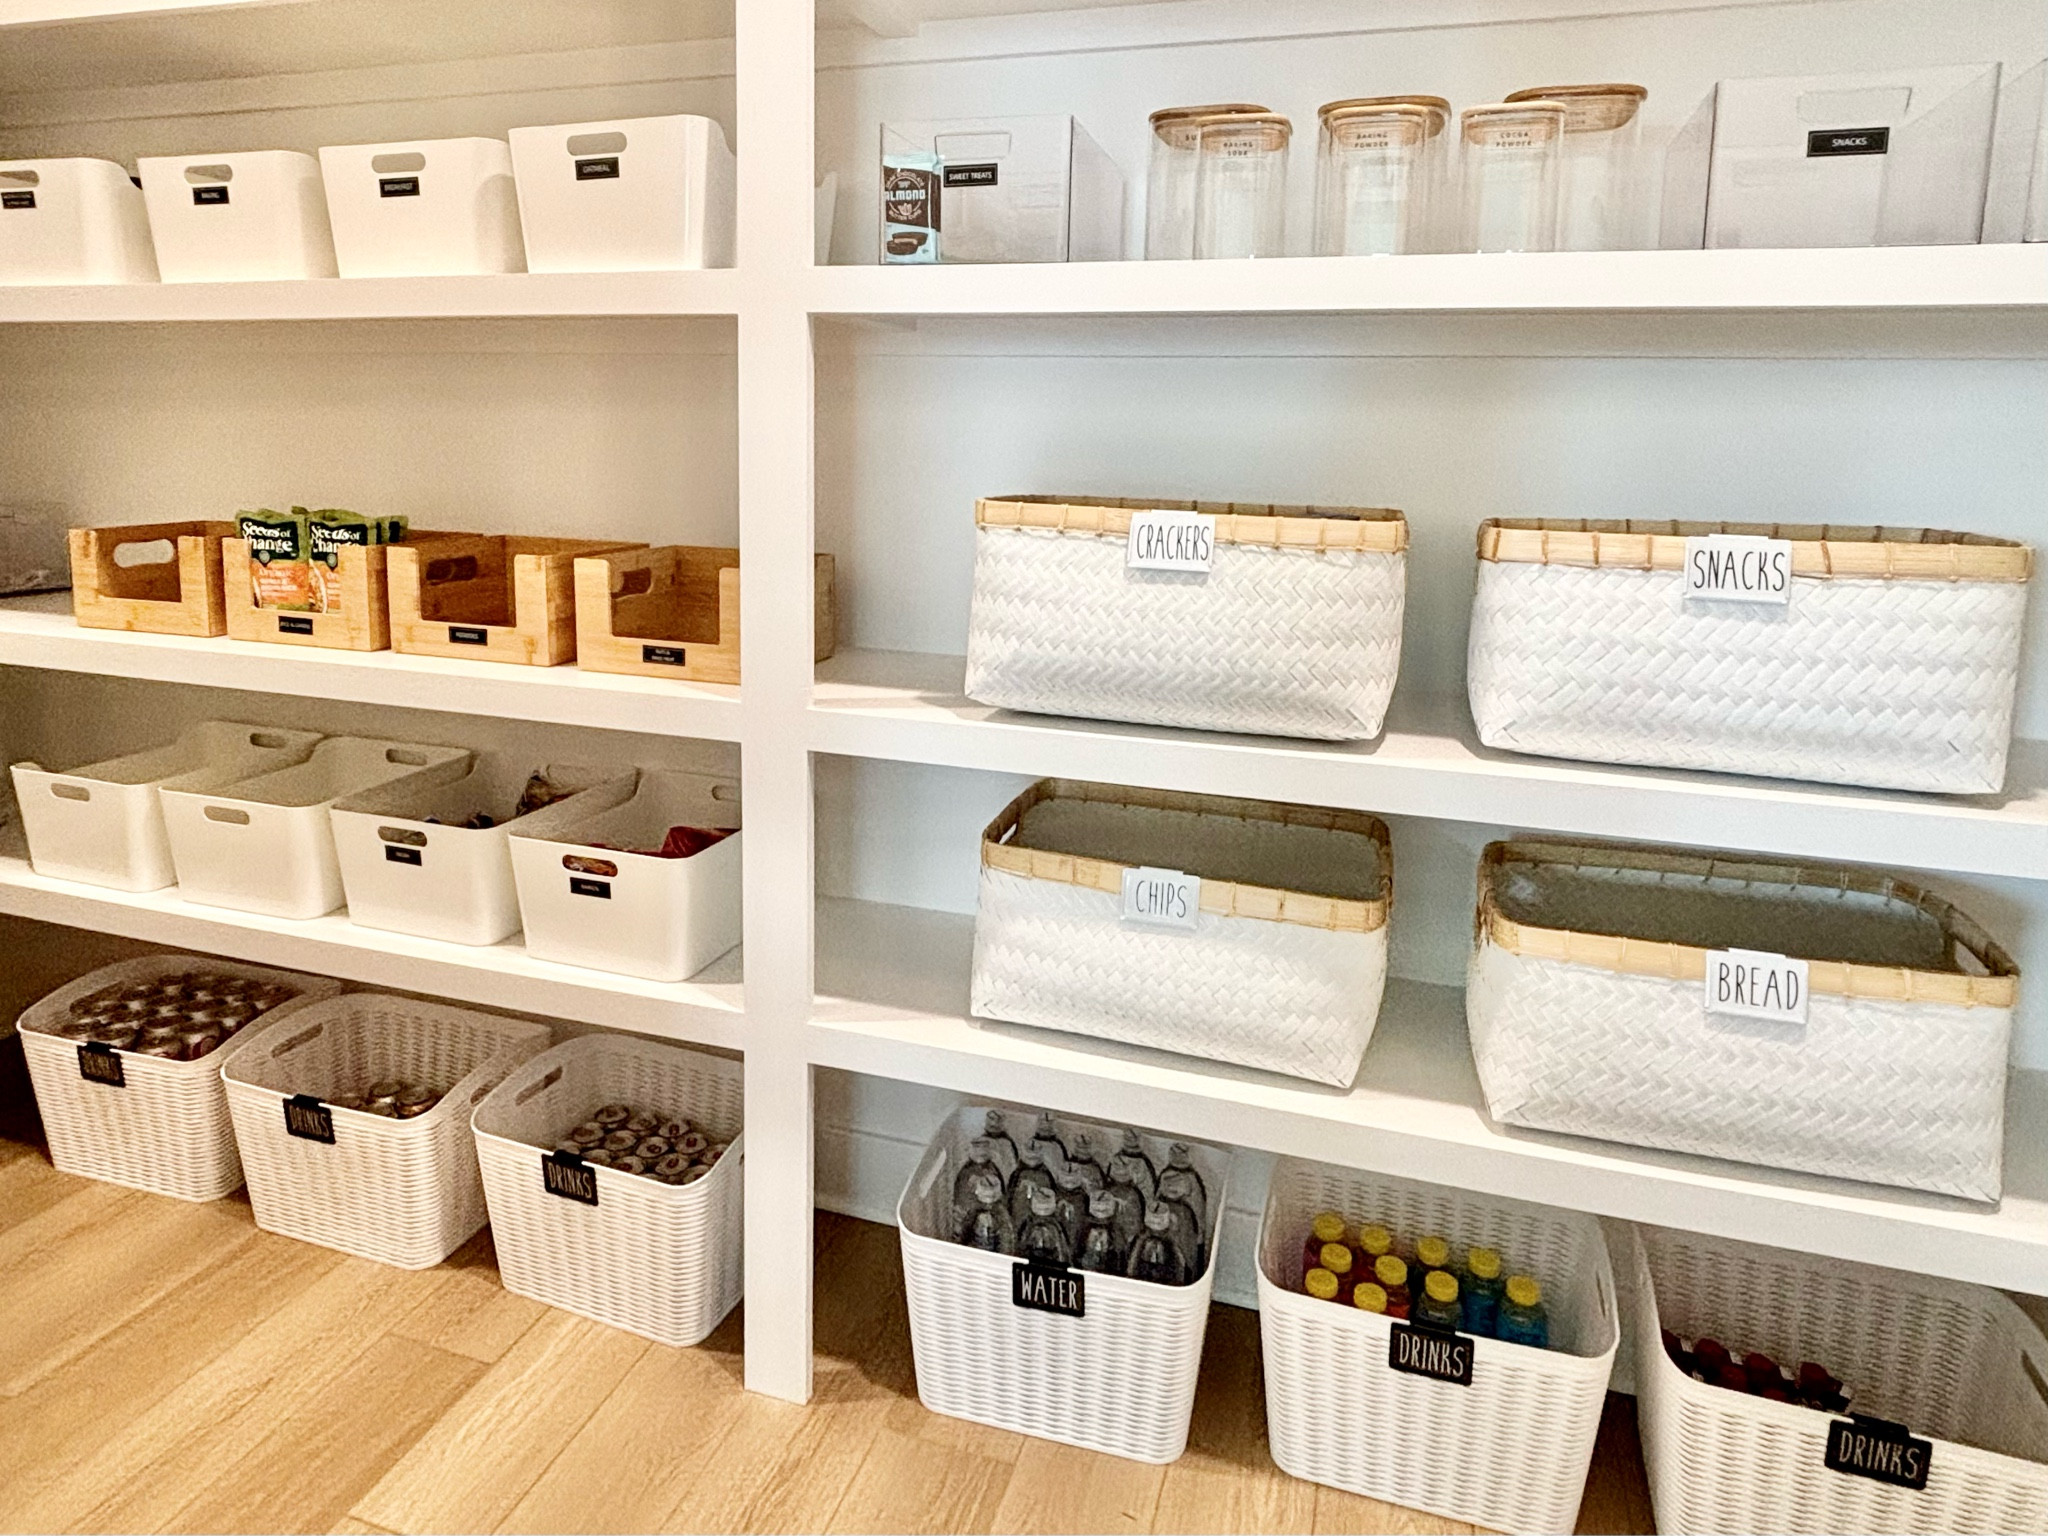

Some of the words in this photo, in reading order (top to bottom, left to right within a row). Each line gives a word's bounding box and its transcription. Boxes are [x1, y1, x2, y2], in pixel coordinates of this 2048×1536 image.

[1354, 141, 1388, 149] POWDER
[1831, 137, 1868, 147] SNACKS
[948, 172, 970, 181] SWEET
[970, 171, 993, 180] TREATS
[1136, 523, 1210, 561] CRACKERS
[1693, 549, 1785, 592] SNACKS
[1135, 880, 1188, 918] CHIPS
[1718, 962, 1799, 1010] BREAD
[289, 1104, 330, 1137] DRINKS
[548, 1161, 592, 1199] DRINKS
[1021, 1270, 1079, 1310] WATER
[1399, 1332, 1465, 1377] DRINKS
[1838, 1430, 1920, 1479] DRINKS
